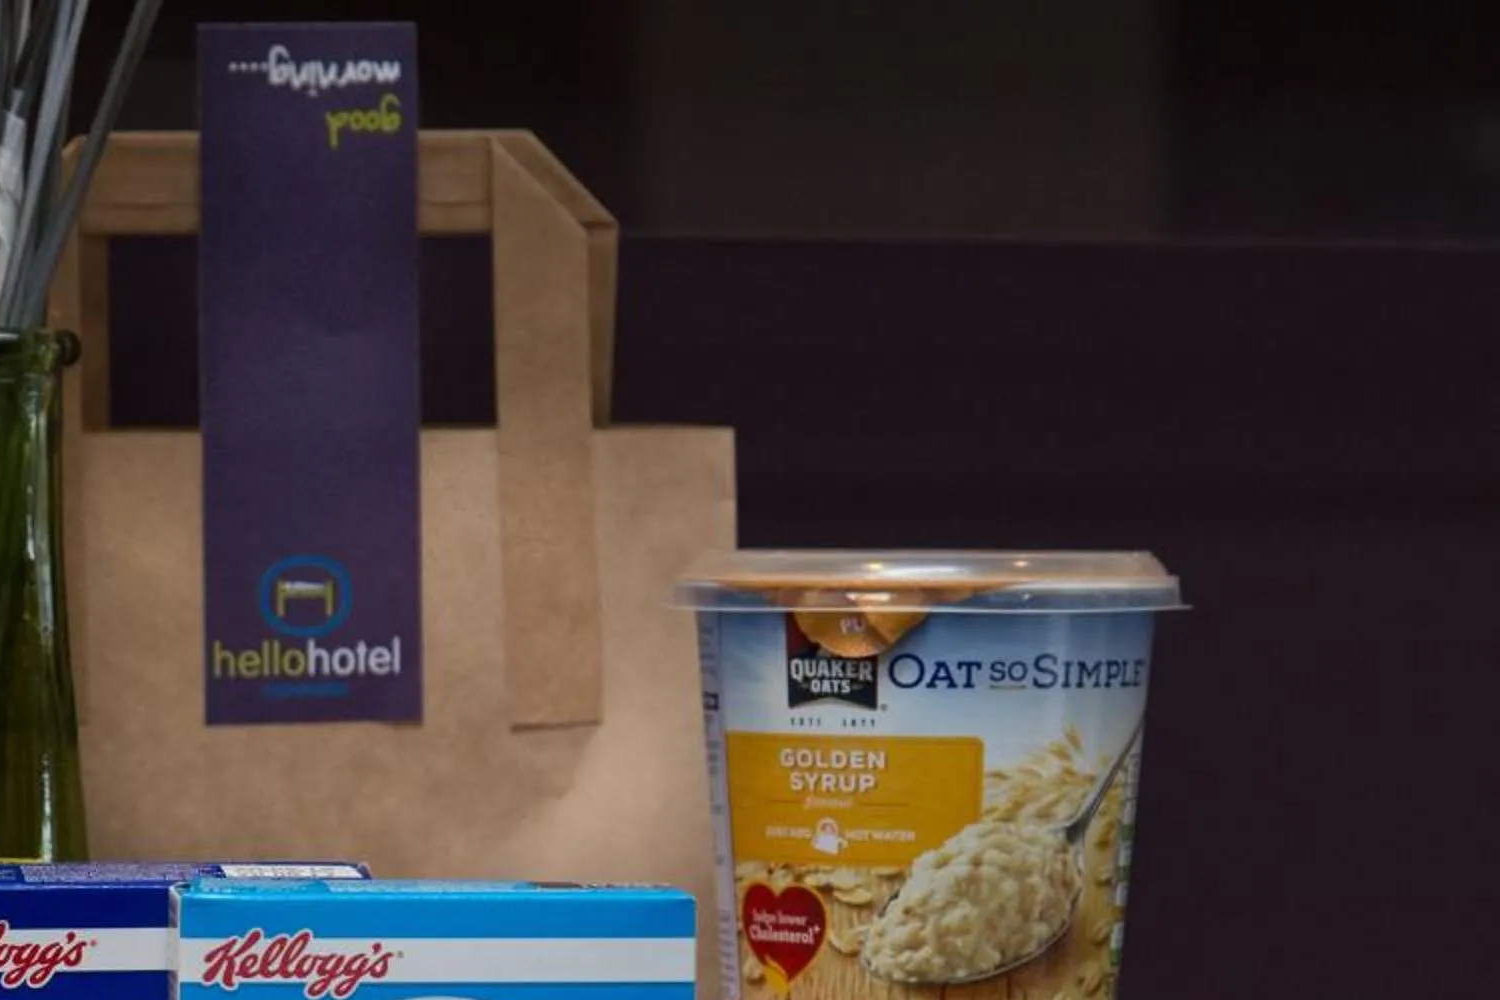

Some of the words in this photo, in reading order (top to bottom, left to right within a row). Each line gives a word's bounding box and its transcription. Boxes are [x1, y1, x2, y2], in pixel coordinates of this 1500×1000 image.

[324, 93, 402, 148] good
[213, 636, 401, 677] hellohotel
[790, 659, 874, 682] QUAKER
[888, 653, 982, 690] OAT
[989, 660, 1029, 683] SO
[1032, 653, 1145, 690] SIMPLE
[810, 679, 851, 693] OATS
[780, 748, 887, 769] GOLDEN
[790, 772, 877, 792] SYRUP
[202, 930, 395, 997] Kellogg's
